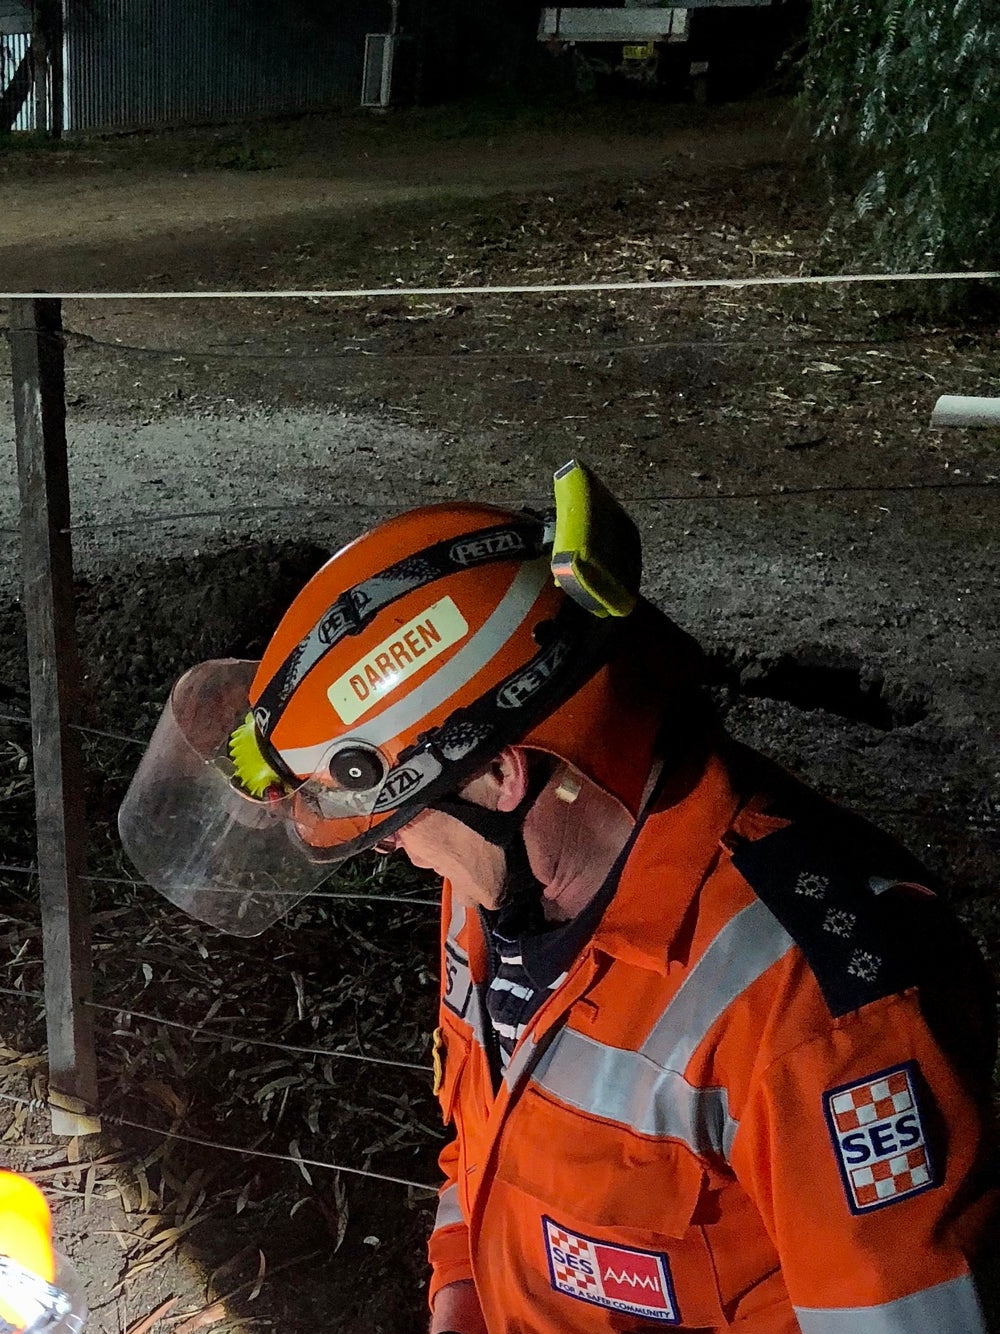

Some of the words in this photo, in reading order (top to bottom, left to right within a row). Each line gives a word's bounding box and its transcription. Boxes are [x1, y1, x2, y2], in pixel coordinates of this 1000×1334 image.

[455, 531, 525, 566] PETZL
[349, 619, 442, 701] DARREN
[841, 1114, 921, 1164] SES
[553, 1247, 594, 1275] SES
[604, 1266, 660, 1292] AAMI
[559, 1282, 575, 1293] FOR
[586, 1292, 611, 1305] SAFER
[613, 1301, 670, 1318] COMMUNITY
